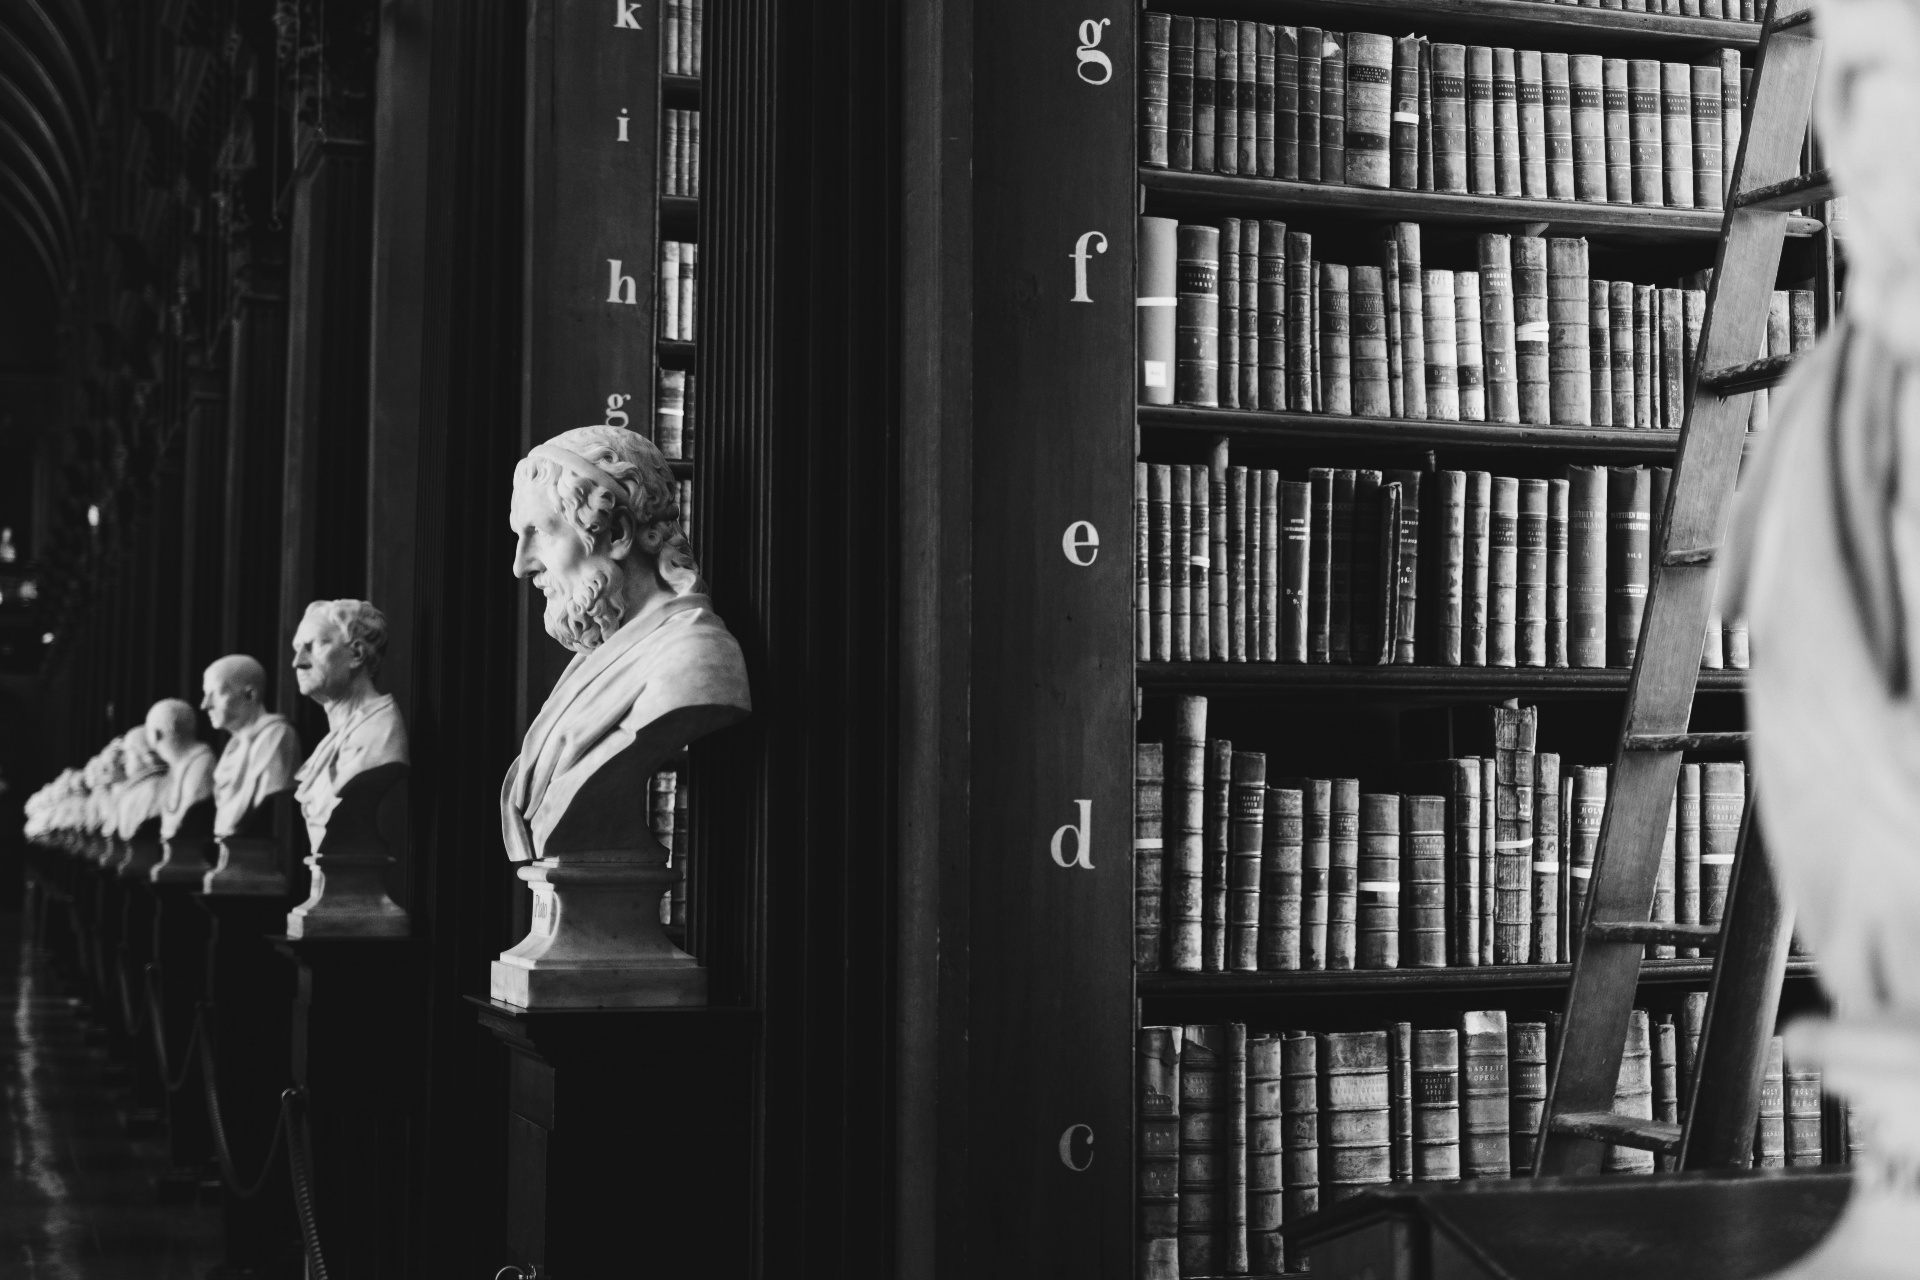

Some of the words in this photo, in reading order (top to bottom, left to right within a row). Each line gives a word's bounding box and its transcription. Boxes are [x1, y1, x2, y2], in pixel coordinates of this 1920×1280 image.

[613, 0, 642, 30] k
[1076, 18, 1112, 86] g
[616, 108, 631, 142] i
[606, 258, 637, 305] h
[1069, 231, 1108, 303] f
[605, 393, 632, 428] g
[1062, 520, 1100, 567] e
[1051, 799, 1095, 870] d
[1059, 1123, 1094, 1171] c
